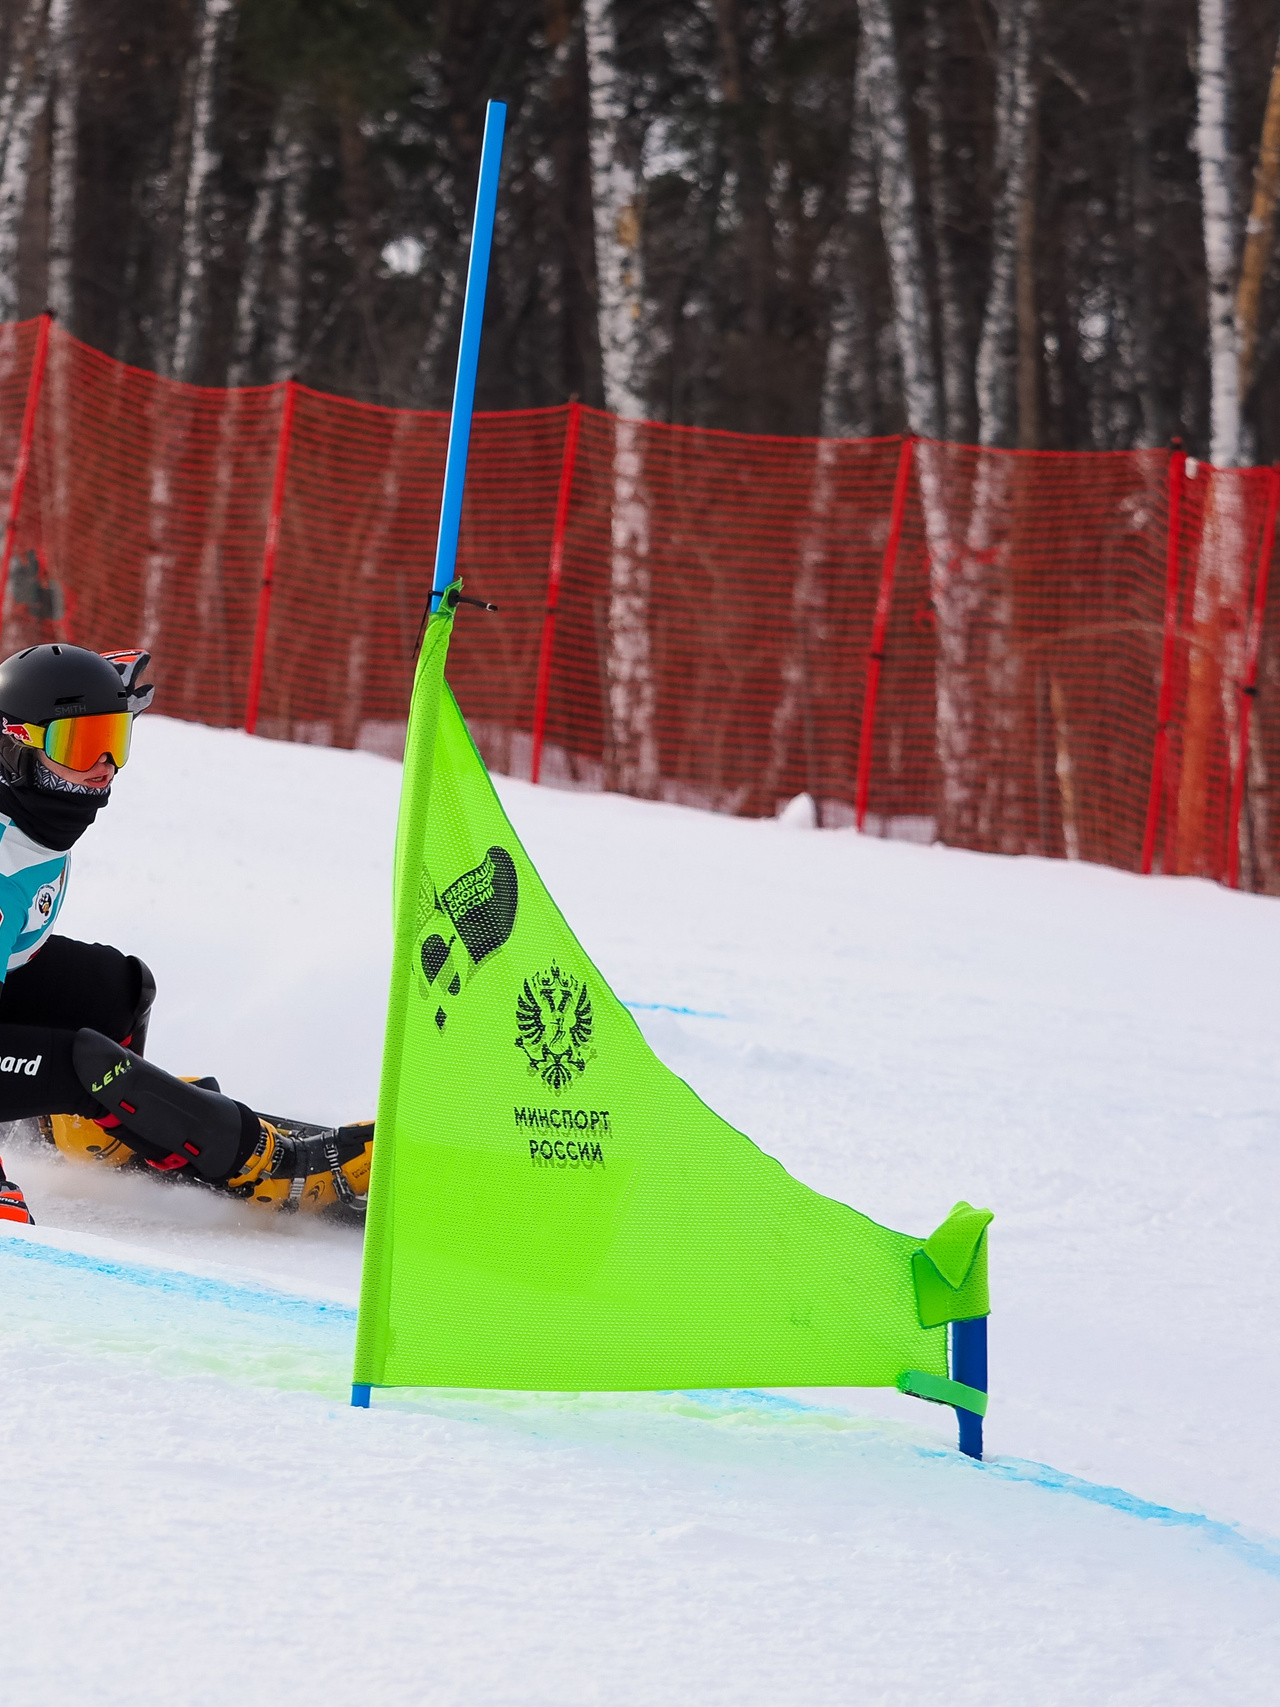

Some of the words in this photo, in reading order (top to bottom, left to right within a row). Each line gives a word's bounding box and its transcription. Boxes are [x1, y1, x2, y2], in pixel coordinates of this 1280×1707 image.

[54, 704, 87, 716] SMITH
[453, 885, 495, 921] РОССИИ
[513, 1106, 610, 1130] МИНСПОРТ
[529, 1139, 604, 1162] РОССИИ
